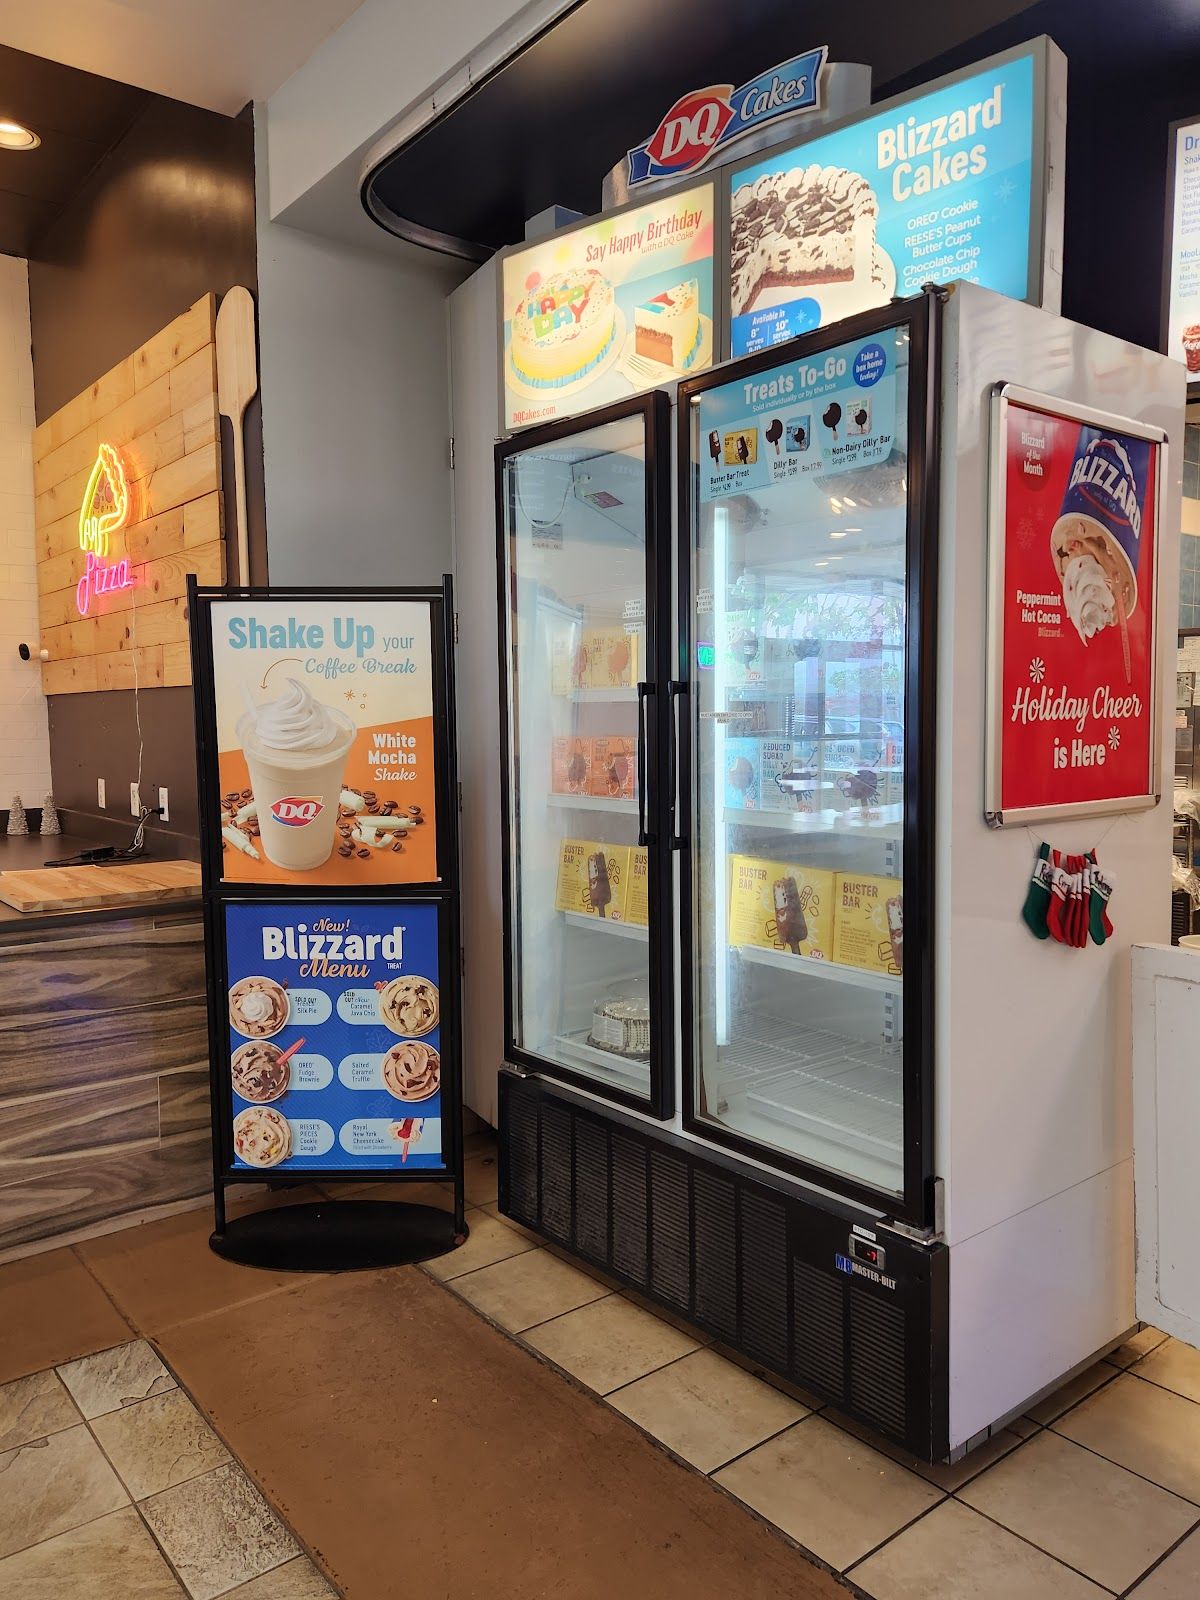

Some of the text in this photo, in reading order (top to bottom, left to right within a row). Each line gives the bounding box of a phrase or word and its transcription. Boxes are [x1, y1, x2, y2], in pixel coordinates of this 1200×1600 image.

[659, 75, 808, 161] DQ Cakes
[877, 84, 1003, 170] Blizzard
[892, 144, 987, 202] Cakes
[907, 199, 978, 230] OREO Cookie
[585, 209, 703, 263] Say Happy Birthday
[904, 215, 982, 248] REESE'S Peanut
[641, 243, 657, 254] with
[664, 237, 675, 247] DQ
[676, 230, 694, 242] Cake
[912, 231, 972, 258] Butter Cups
[902, 246, 980, 277] Chocolate Chip
[904, 260, 977, 288] Cookie Dough
[533, 297, 590, 338] DAY
[752, 308, 786, 326] Available in
[861, 350, 879, 362] Take a
[855, 358, 883, 374] box home
[743, 356, 847, 405] Treats To-Go
[752, 402, 765, 413] Sold
[797, 391, 805, 399] or
[805, 388, 814, 398] by
[813, 385, 824, 393] the
[824, 382, 837, 391] box
[512, 405, 556, 424] DQCakes.com
[831, 442, 861, 456] Non-Dairy
[862, 438, 877, 449] Dilly
[879, 435, 891, 444] Bar
[1021, 431, 1045, 449] Blizzard
[863, 450, 872, 458] Box
[1026, 450, 1033, 460] of
[773, 457, 798, 470] Dilly Bar
[1023, 460, 1043, 477] Month
[710, 469, 750, 485] Buster Bar Treat
[1068, 455, 1141, 540] BLIZZARD
[76, 551, 135, 616] Pizza
[1016, 590, 1062, 608] Peppermint
[1021, 608, 1061, 625] Hot Cocoa
[227, 616, 414, 657] Shake Up your
[305, 657, 416, 679] Coffee Break
[1011, 685, 1142, 733] Holiday Cheer
[372, 732, 416, 748] White
[763, 742, 791, 751] REDUCED
[368, 749, 416, 765] Mocha
[1053, 737, 1106, 769] is Here
[373, 767, 417, 781] Shake
[276, 802, 318, 820] DQ
[563, 854, 575, 864] BAR
[564, 845, 585, 856] BUSTER
[634, 854, 648, 865] BUS
[633, 865, 647, 876] BAR
[739, 866, 768, 881] BUSTER
[738, 878, 753, 890] BAR
[843, 882, 878, 898] BUSTER
[842, 894, 860, 909] BAR
[312, 917, 350, 932] New!
[262, 923, 404, 961] Blizzard
[299, 957, 371, 979] Menu
[386, 962, 402, 970] TREAT
[352, 1123, 368, 1131] Royal
[300, 1145, 317, 1153] Dough
[851, 1261, 897, 1290] MASTER-BILT
